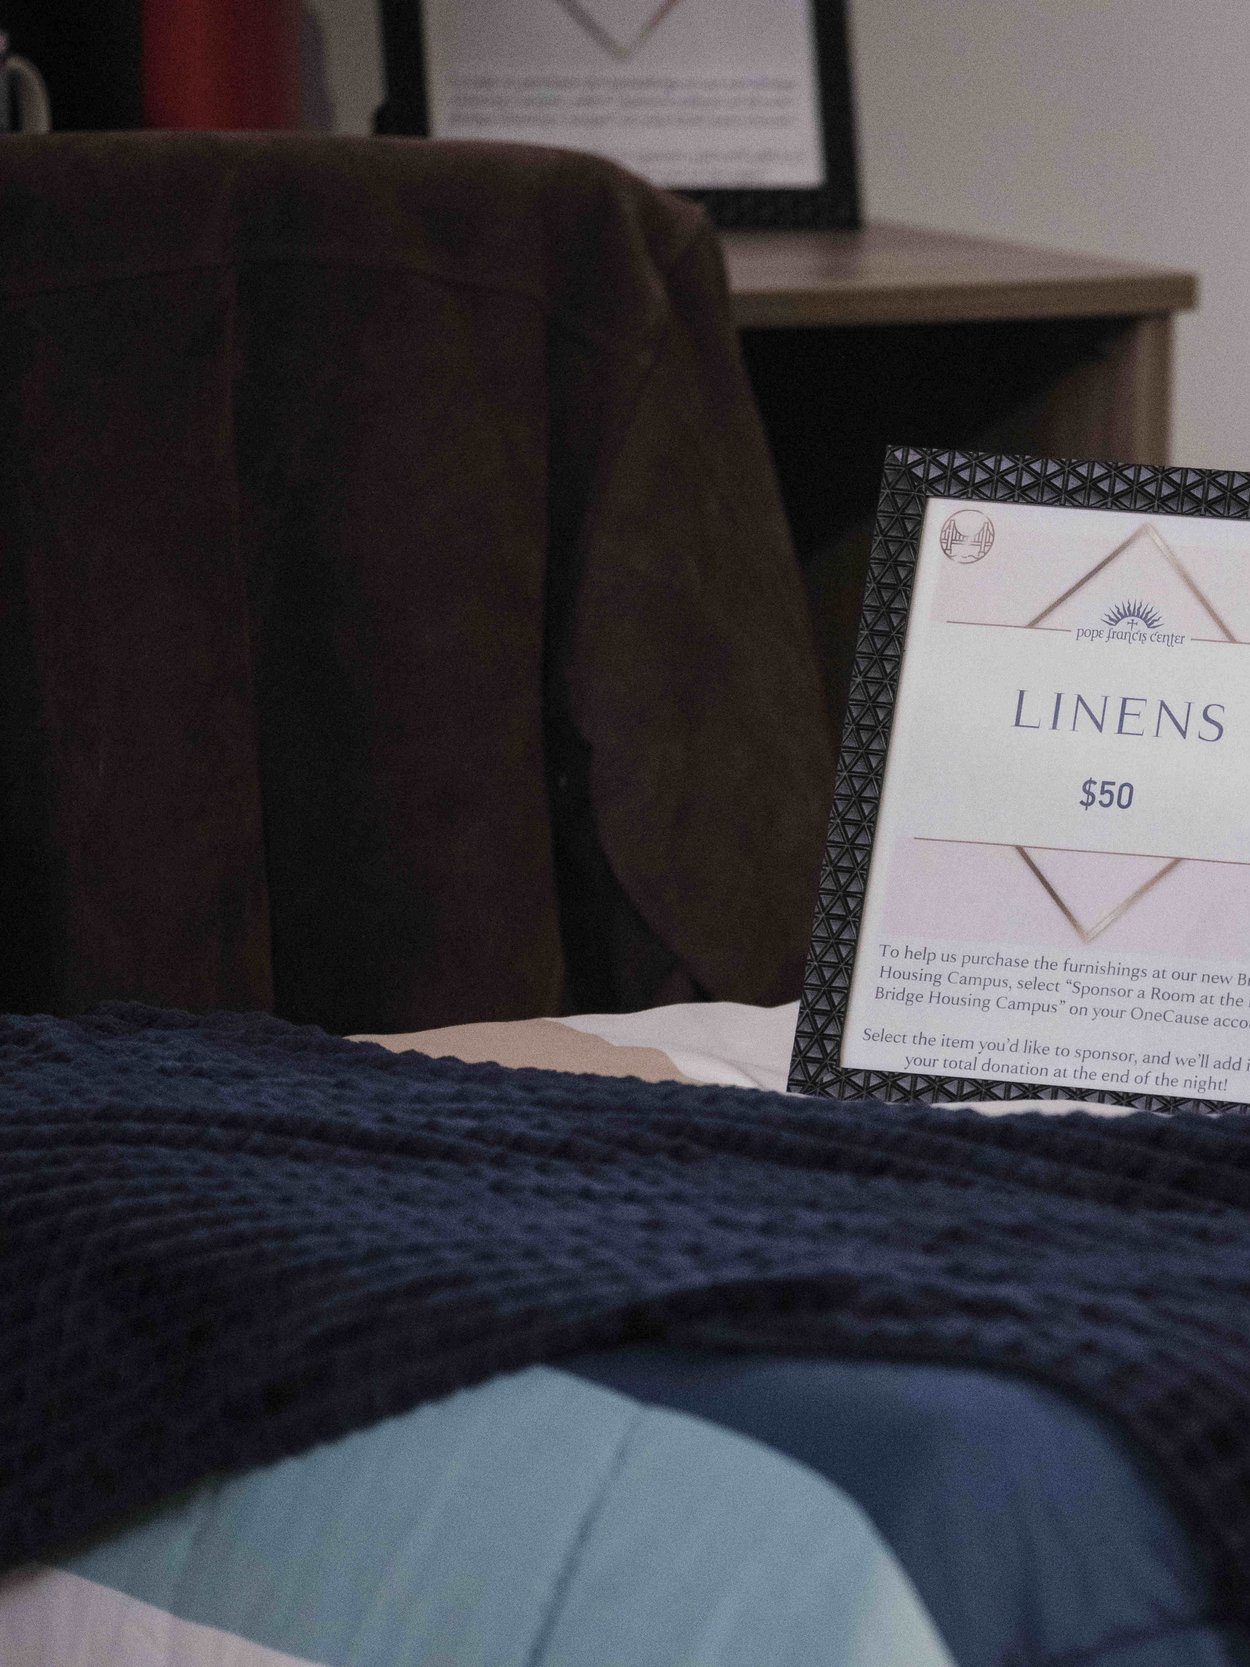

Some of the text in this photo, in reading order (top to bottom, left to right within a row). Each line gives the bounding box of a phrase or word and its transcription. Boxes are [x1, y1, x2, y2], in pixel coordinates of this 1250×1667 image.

[1075, 627, 1186, 648] pope francis center
[1011, 688, 1226, 743] LINENS
[1078, 776, 1135, 812] $50
[879, 943, 900, 959] To
[903, 944, 937, 966] help
[940, 952, 957, 963] us
[960, 951, 1030, 969] purchase
[1033, 955, 1059, 971] the
[1063, 957, 1148, 982] furnishings
[1151, 968, 1167, 980] at
[1170, 970, 1198, 982] our
[1200, 973, 1234, 985] new
[874, 985, 925, 1007] Bridge
[928, 990, 992, 1013] Housing
[995, 996, 1067, 1016] Campus”
[1068, 1005, 1089, 1017] on
[1091, 1007, 1128, 1022] your
[1129, 1006, 1210, 1027] OneCause
[879, 965, 943, 988] Housing
[946, 970, 1012, 991] Campus,
[1016, 975, 1061, 993] select
[1065, 979, 1135, 999] “Sponsor
[1136, 989, 1146, 1000] a
[1150, 986, 1196, 1004] Room
[1199, 994, 1215, 1006] at
[1219, 991, 1245, 1008] the
[862, 1027, 908, 1045] Select
[911, 1031, 937, 1047] the
[940, 1033, 975, 1050] item
[977, 1037, 1020, 1055] you’d
[1022, 1039, 1051, 1056] like
[1054, 1045, 1071, 1058] to
[1073, 1048, 1138, 1066] sponsor,
[1141, 1050, 1172, 1066] and
[1174, 1053, 1210, 1069] we’ll
[1212, 1055, 1243, 1072] add
[903, 1055, 1229, 1093] your total donation at the end of the night!
